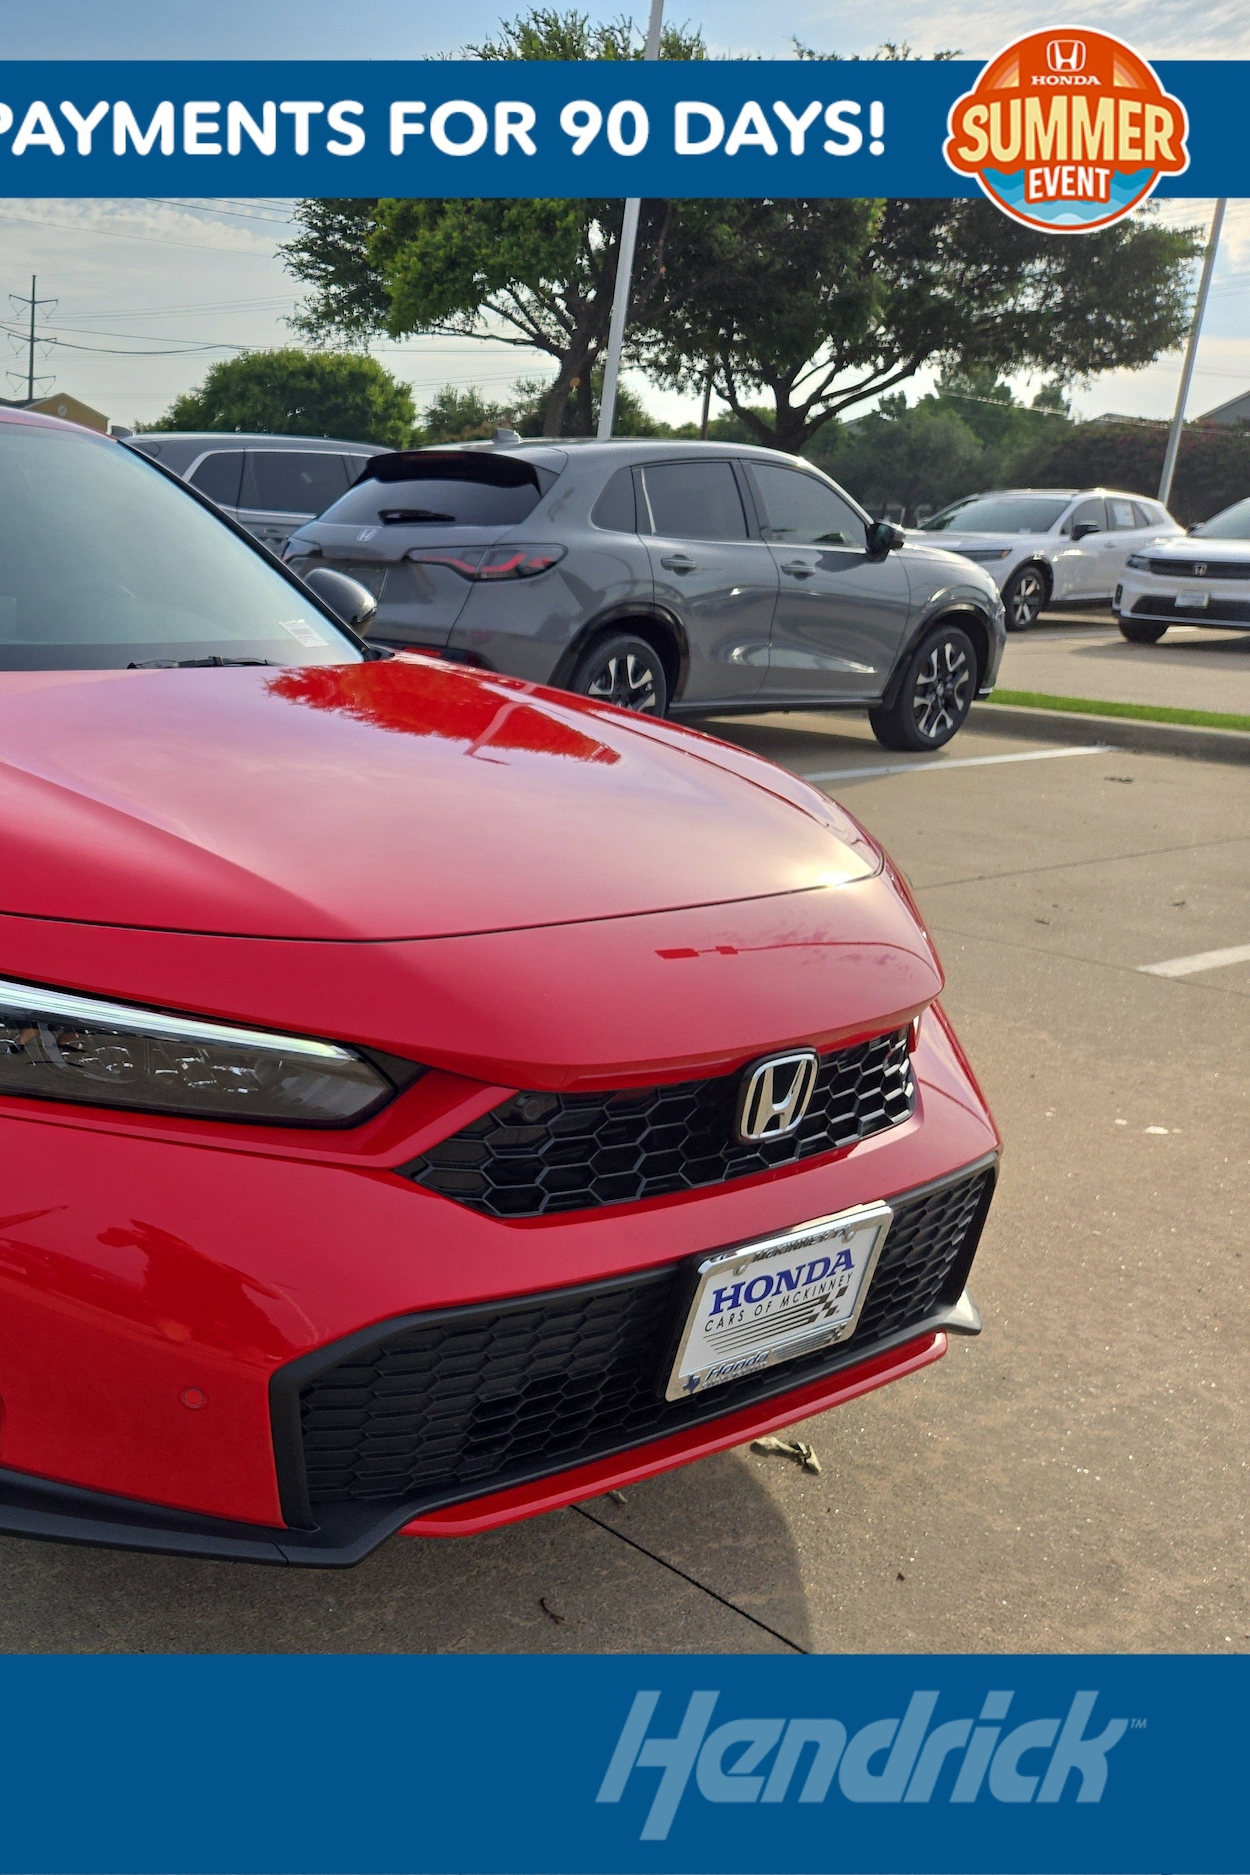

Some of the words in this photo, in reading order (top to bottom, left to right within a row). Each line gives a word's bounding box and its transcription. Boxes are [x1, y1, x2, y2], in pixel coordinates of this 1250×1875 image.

[704, 1309, 745, 1332] CARS
[754, 1301, 773, 1317] OF
[779, 1271, 854, 1309] MCKINNEY
[708, 1248, 855, 1317] HONDA
[705, 1350, 770, 1381] Honda
